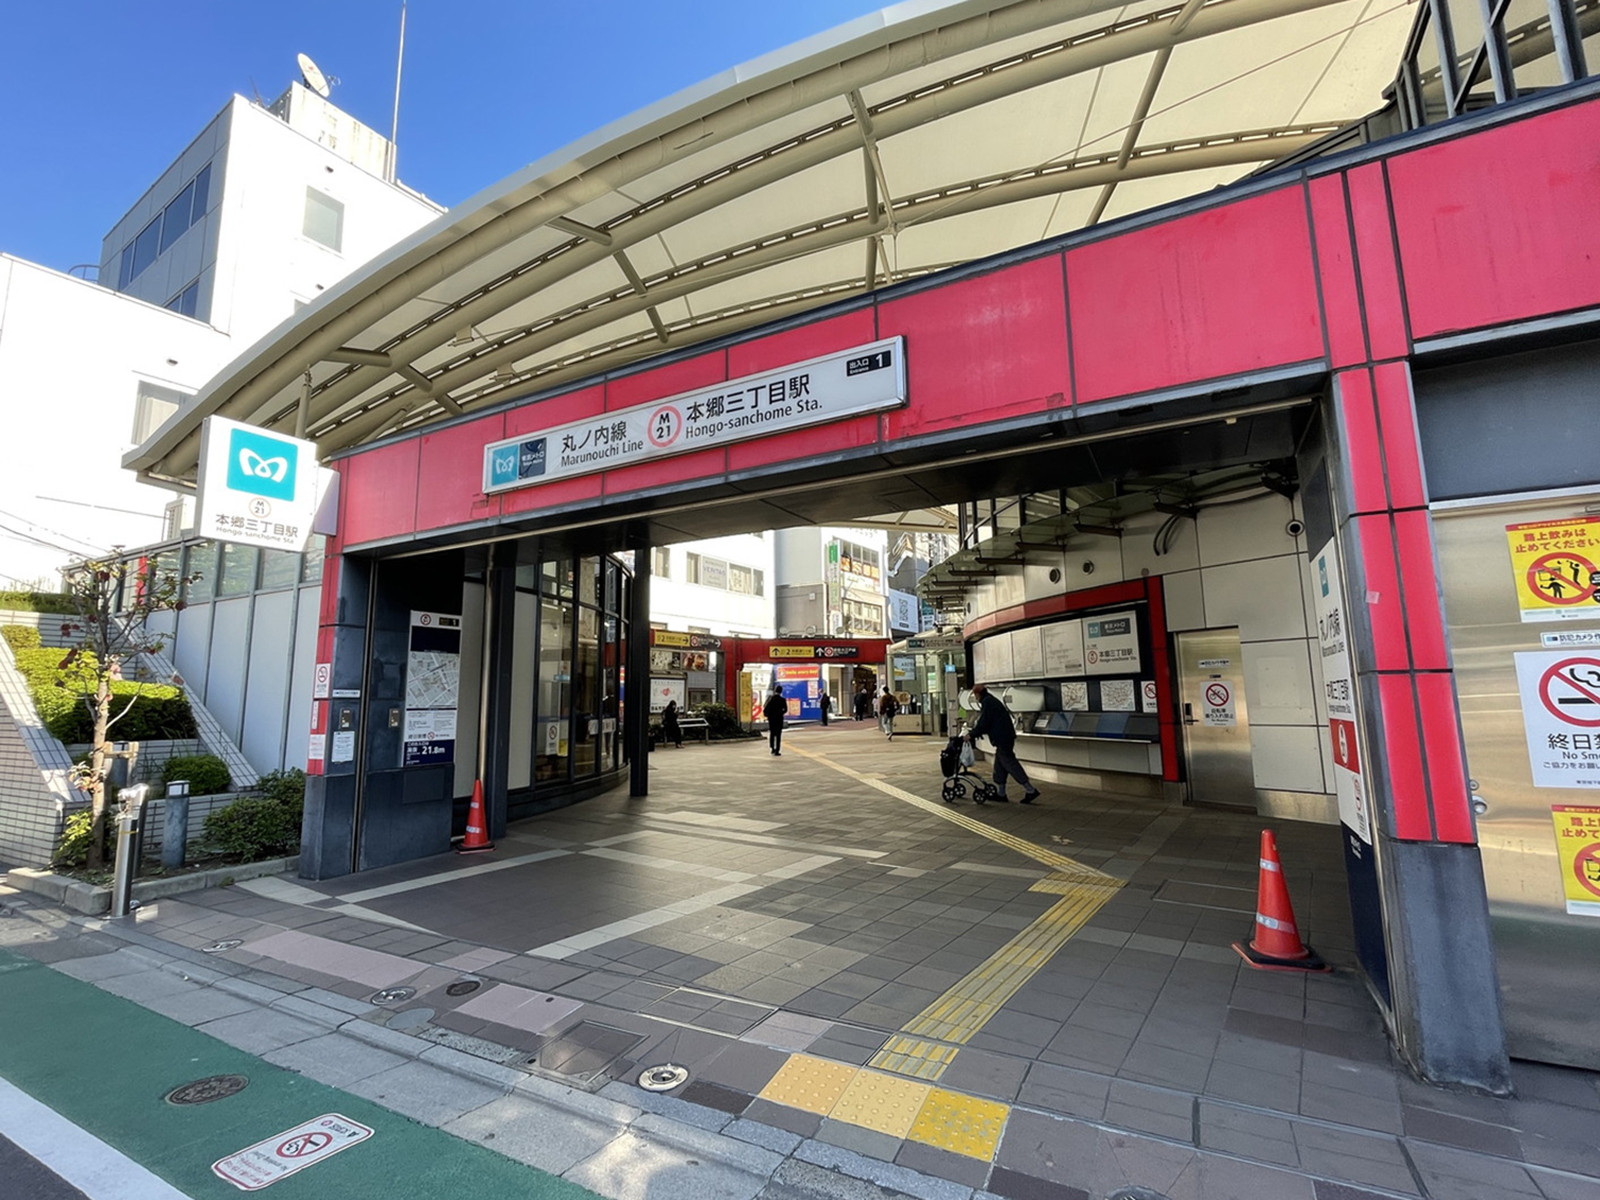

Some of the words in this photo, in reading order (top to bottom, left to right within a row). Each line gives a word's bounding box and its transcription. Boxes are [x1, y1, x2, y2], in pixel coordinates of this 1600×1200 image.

[875, 353, 883, 368] 1
[686, 373, 810, 423] 本郷三丁目駅
[658, 412, 671, 426] M
[685, 404, 793, 440] Hongo-sanchome
[796, 398, 823, 414] Sta.
[561, 420, 627, 454] 丸ノ内線
[656, 425, 672, 440] 21
[560, 442, 620, 468] Marunouchi
[621, 438, 644, 453] Line
[254, 506, 265, 515] 21
[215, 513, 299, 538] 本郷三丁目駅
[1523, 528, 1587, 542] 路上飲みは
[1515, 538, 1600, 553] 止めてください
[1562, 751, 1578, 760] No
[1570, 817, 1600, 828] 路上
